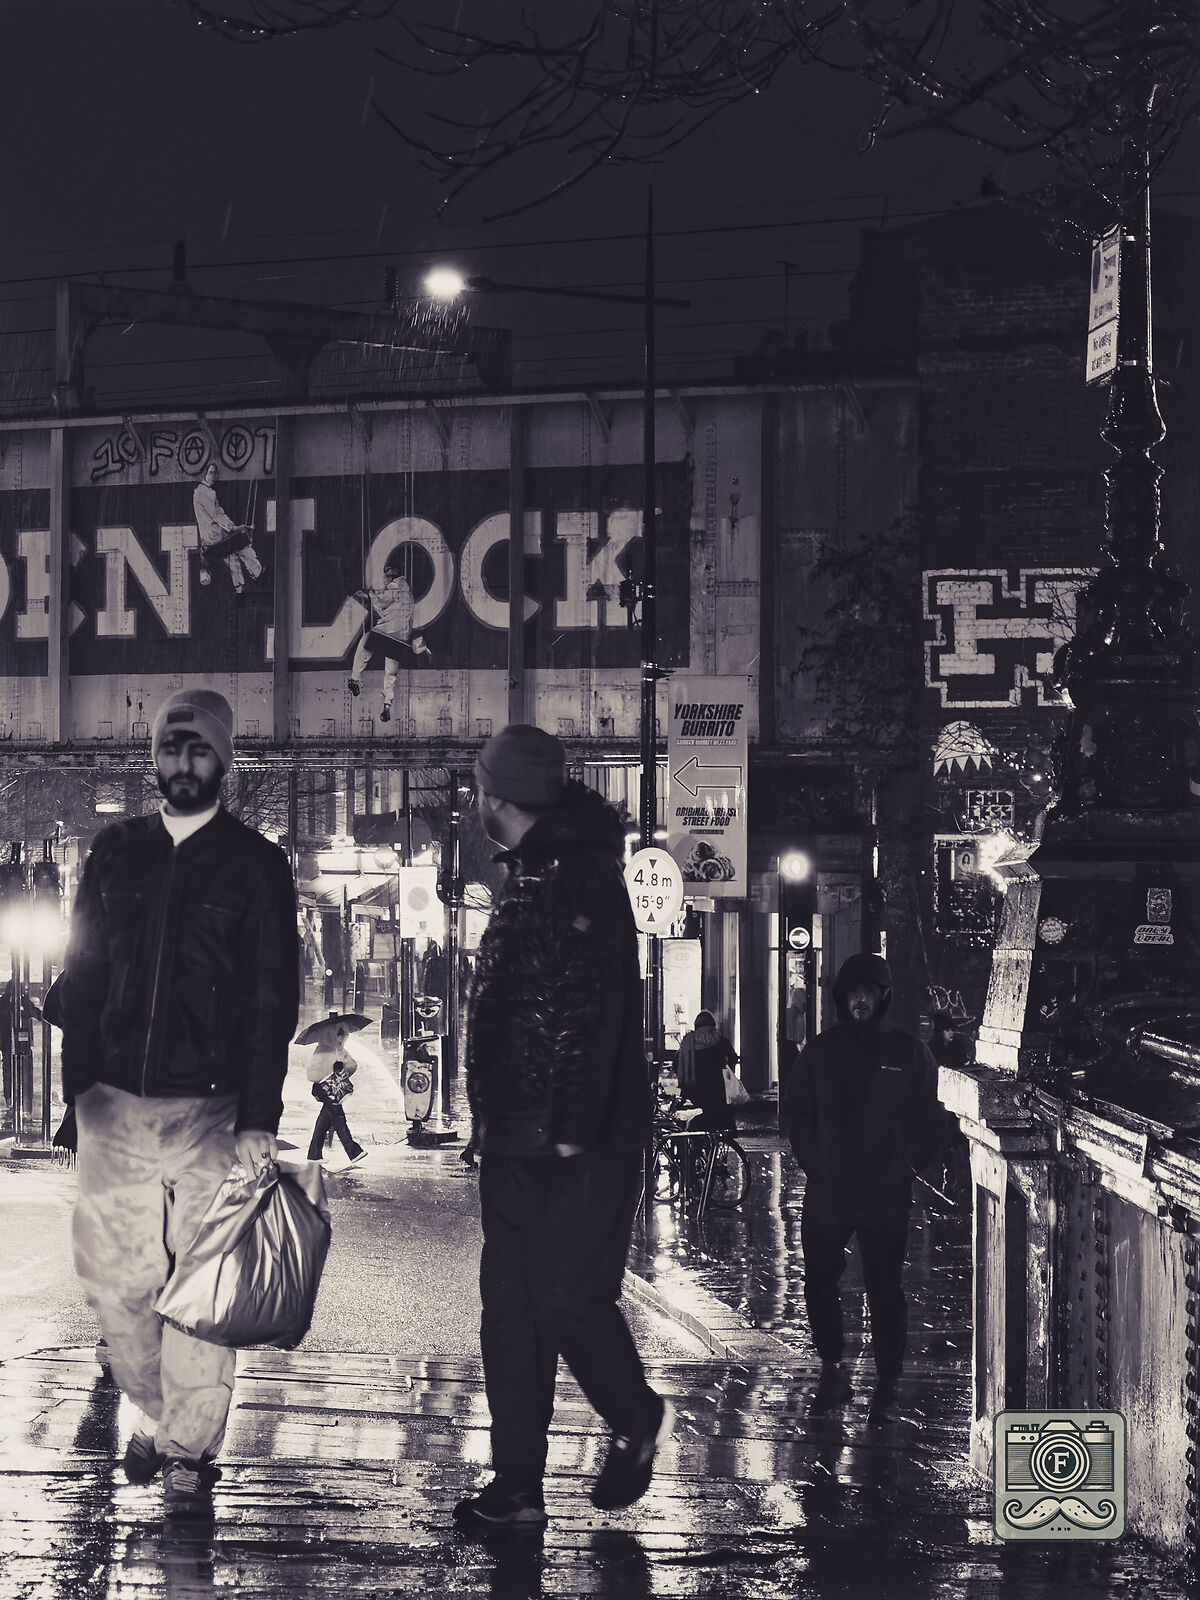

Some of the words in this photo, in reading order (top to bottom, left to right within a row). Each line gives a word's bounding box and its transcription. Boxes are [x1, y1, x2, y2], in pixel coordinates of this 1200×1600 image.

[265, 498, 660, 660] LOCK
[673, 703, 744, 720] YORKSHIRE
[680, 720, 735, 737] BURRITO
[682, 817, 709, 826] STREET
[711, 817, 730, 826] FOOD
[633, 869, 658, 887] 4.8
[662, 876, 672, 887] m
